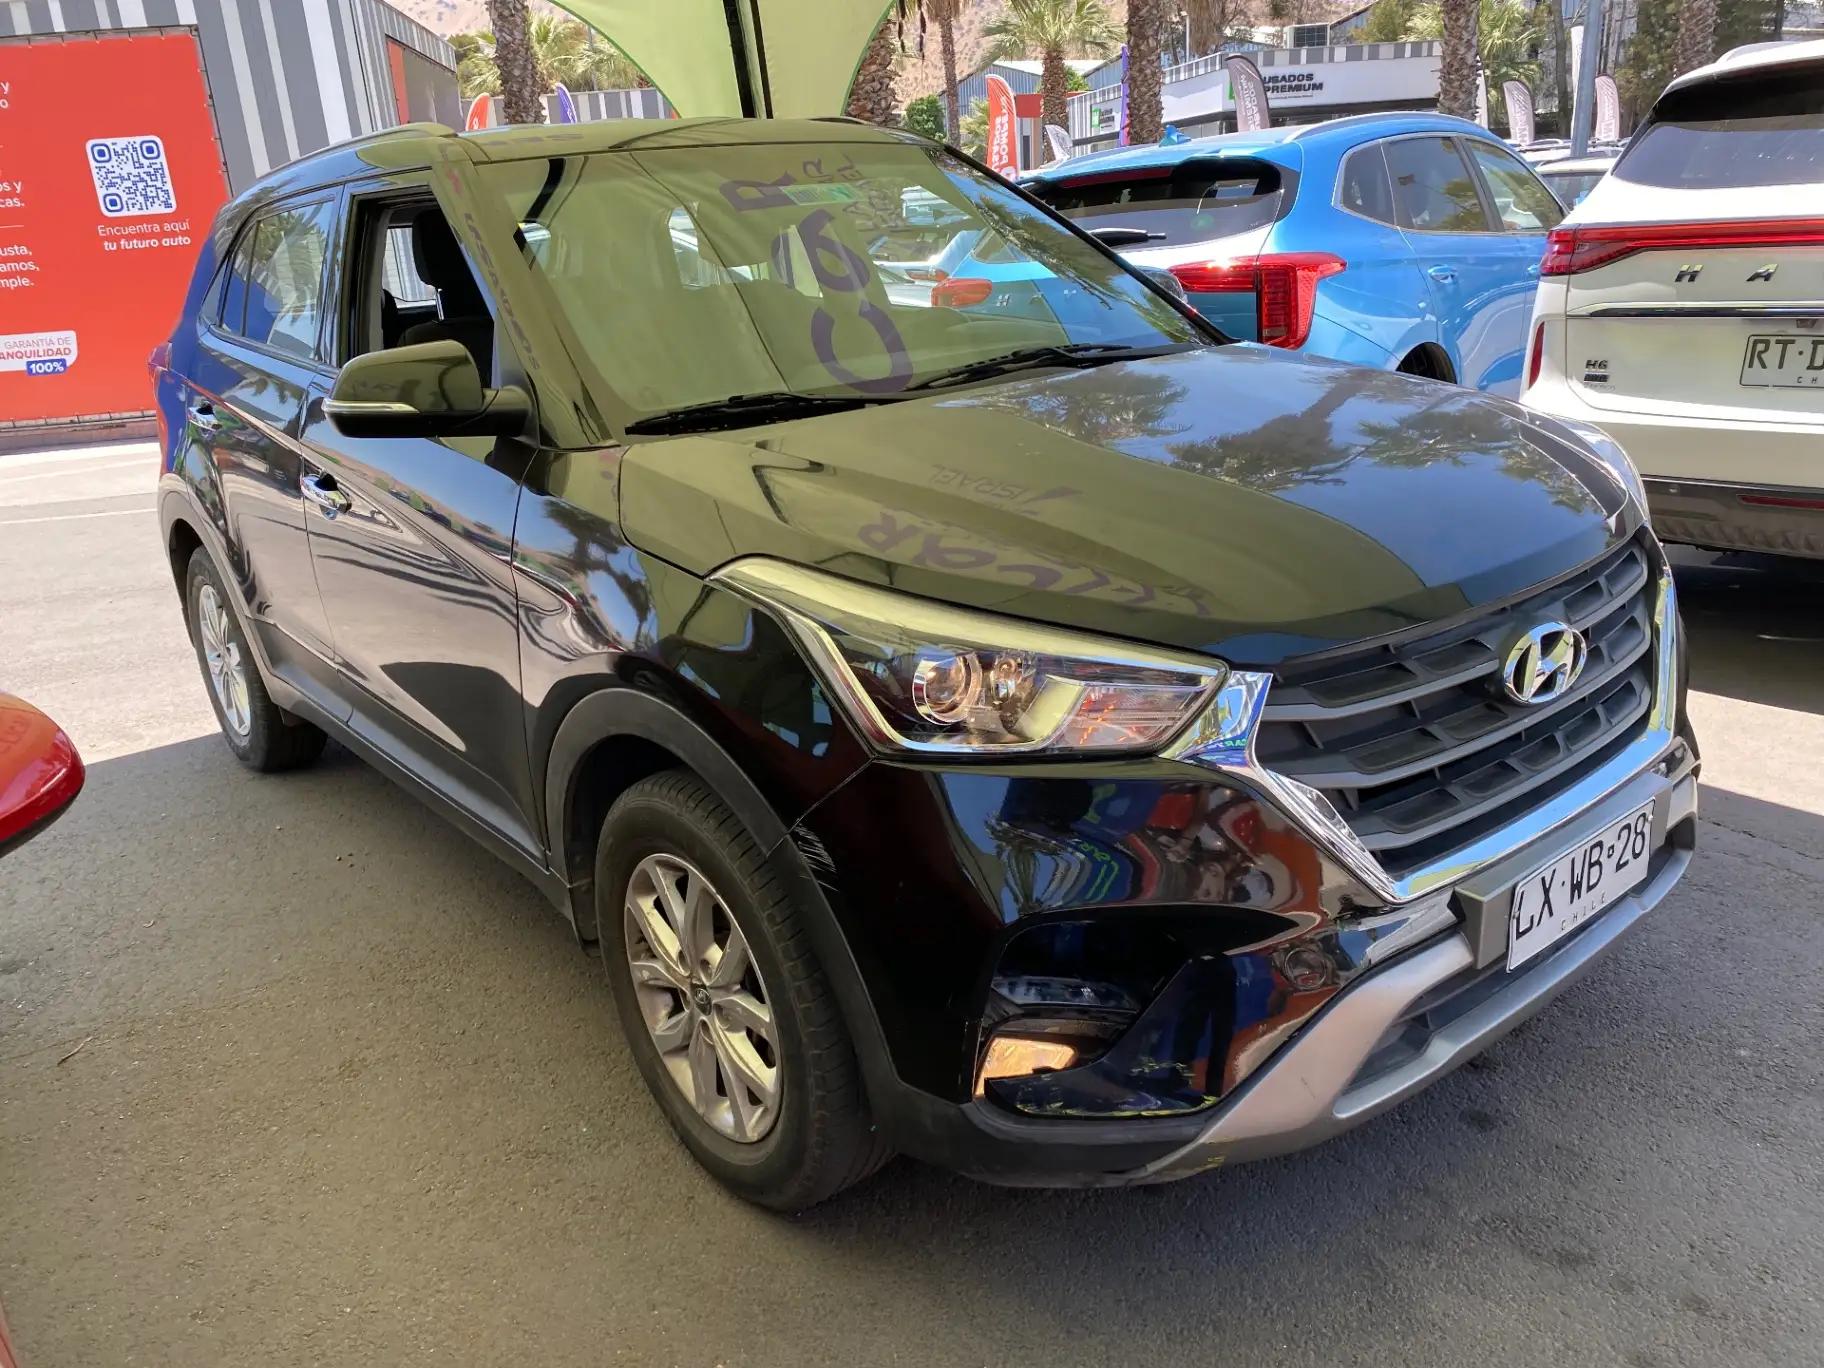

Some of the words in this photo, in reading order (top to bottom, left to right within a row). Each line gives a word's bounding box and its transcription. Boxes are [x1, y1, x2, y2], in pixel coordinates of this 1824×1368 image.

[1263, 73, 1314, 84] USADOS
[1264, 82, 1324, 93] PREMIUM
[97, 224, 161, 237] Encuentra
[163, 218, 190, 233] aquí
[103, 240, 118, 251] tu
[120, 237, 159, 250] futuro
[162, 235, 191, 247] auto
[57, 336, 71, 346] DE
[29, 361, 65, 374] 100%
[1585, 359, 1609, 370] H6
